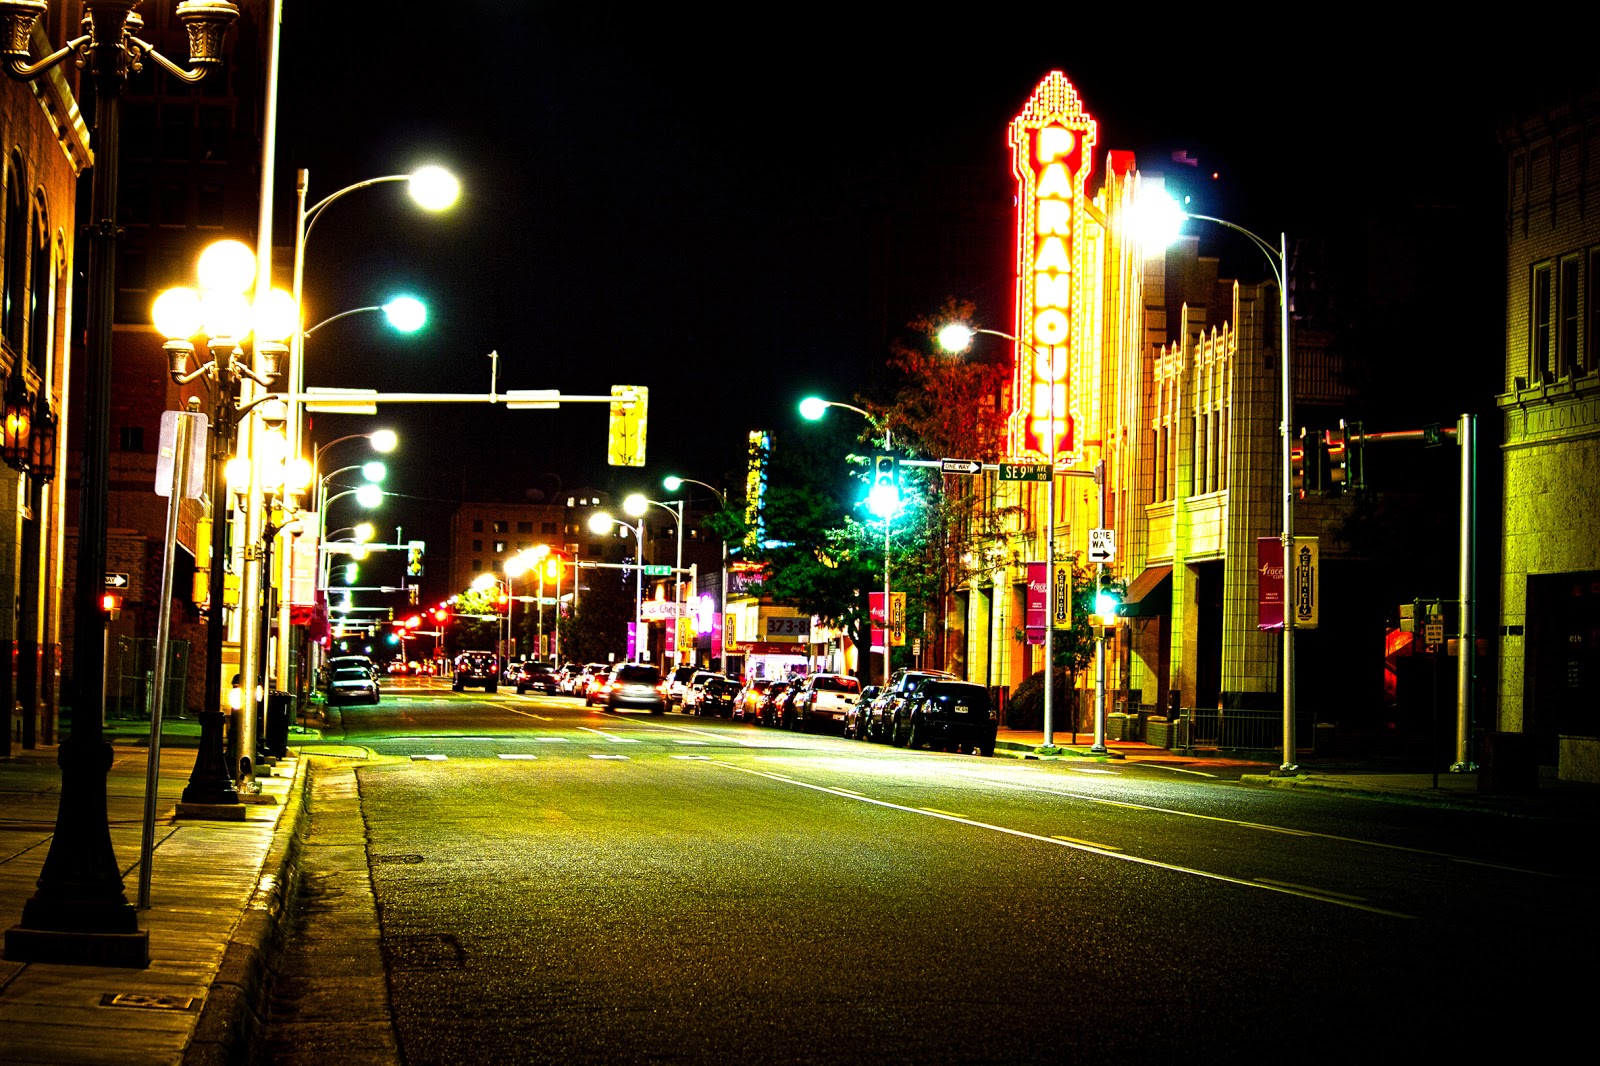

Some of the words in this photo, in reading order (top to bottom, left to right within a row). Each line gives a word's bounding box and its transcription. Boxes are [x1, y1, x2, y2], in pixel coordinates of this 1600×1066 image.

[1033, 126, 1076, 454] PARAMOUNT
[1005, 465, 1018, 479] SE
[1020, 465, 1034, 479] 9TH
[1037, 465, 1047, 473] AVE
[1037, 473, 1047, 481] 100
[1093, 531, 1111, 540] ONE
[1092, 540, 1112, 549] WA
[1301, 555, 1309, 588] CENTER
